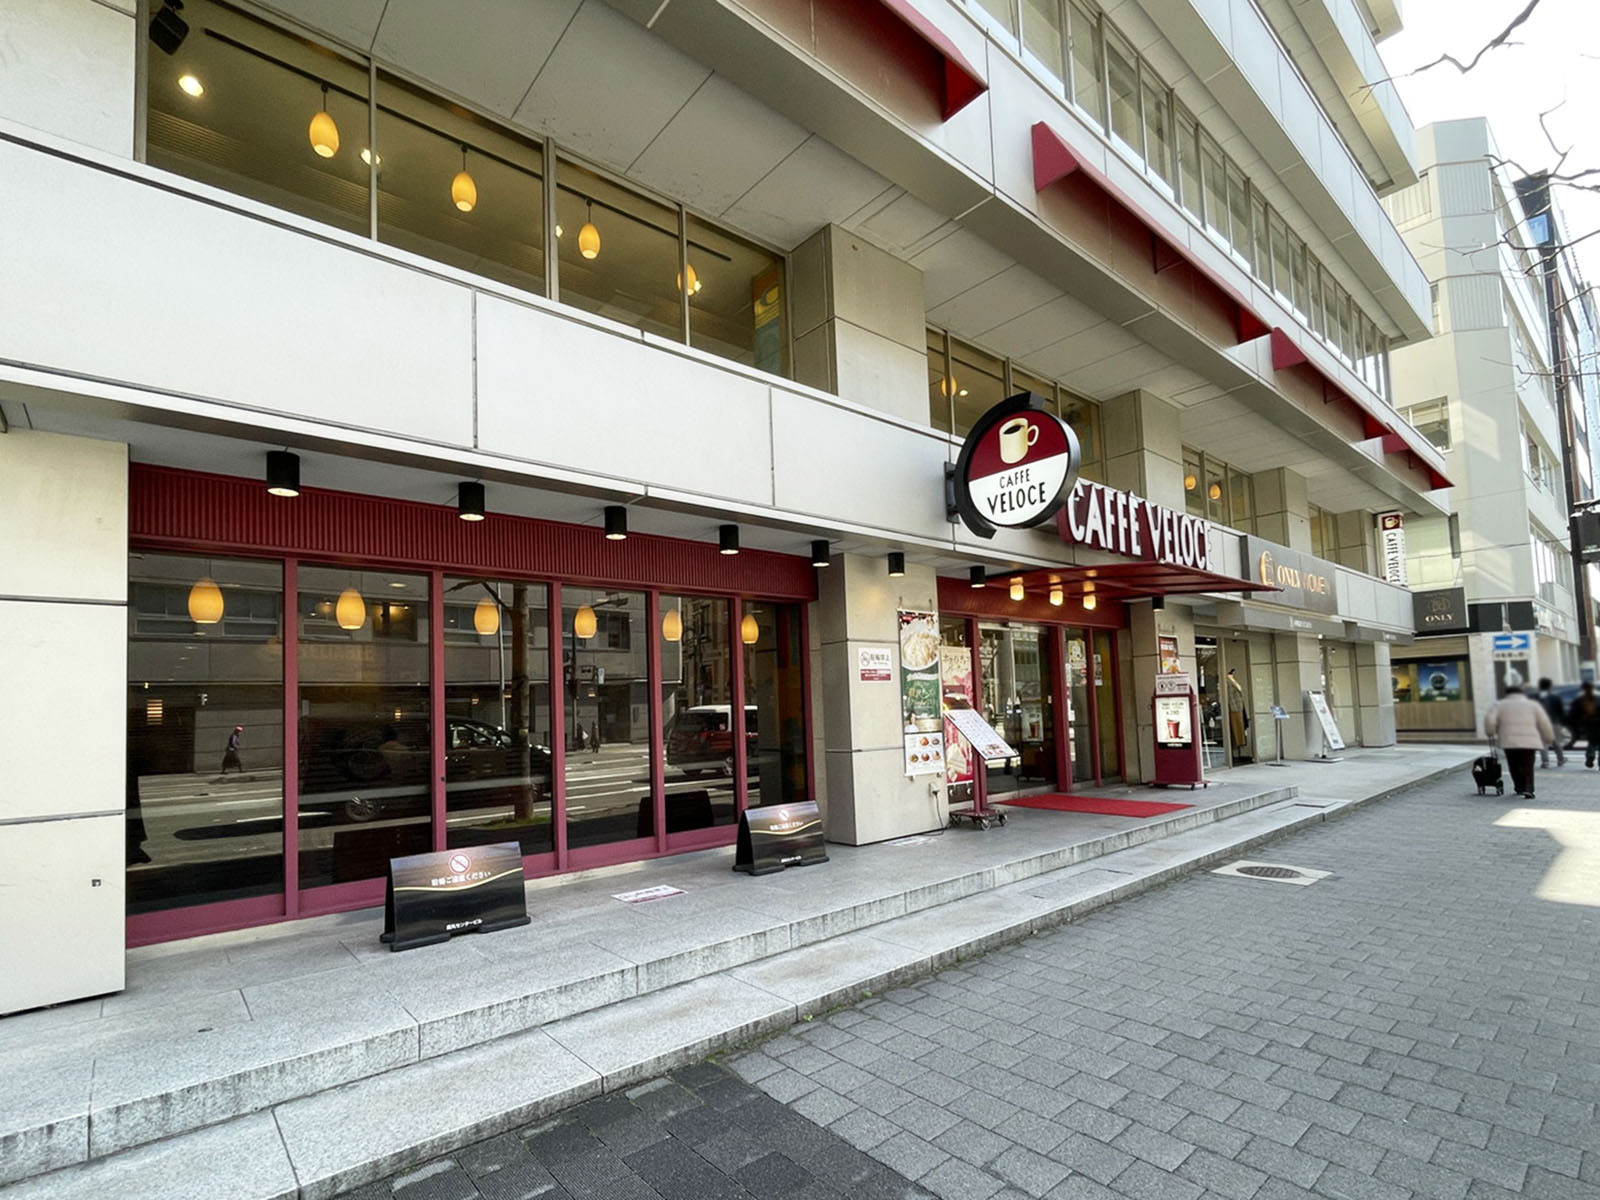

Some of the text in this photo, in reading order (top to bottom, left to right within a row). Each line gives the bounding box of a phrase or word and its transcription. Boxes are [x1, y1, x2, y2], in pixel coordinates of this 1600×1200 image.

[987, 481, 1046, 515] VELOCE
[1144, 499, 1214, 573] VELOCE
[1424, 614, 1454, 623] ONLY
